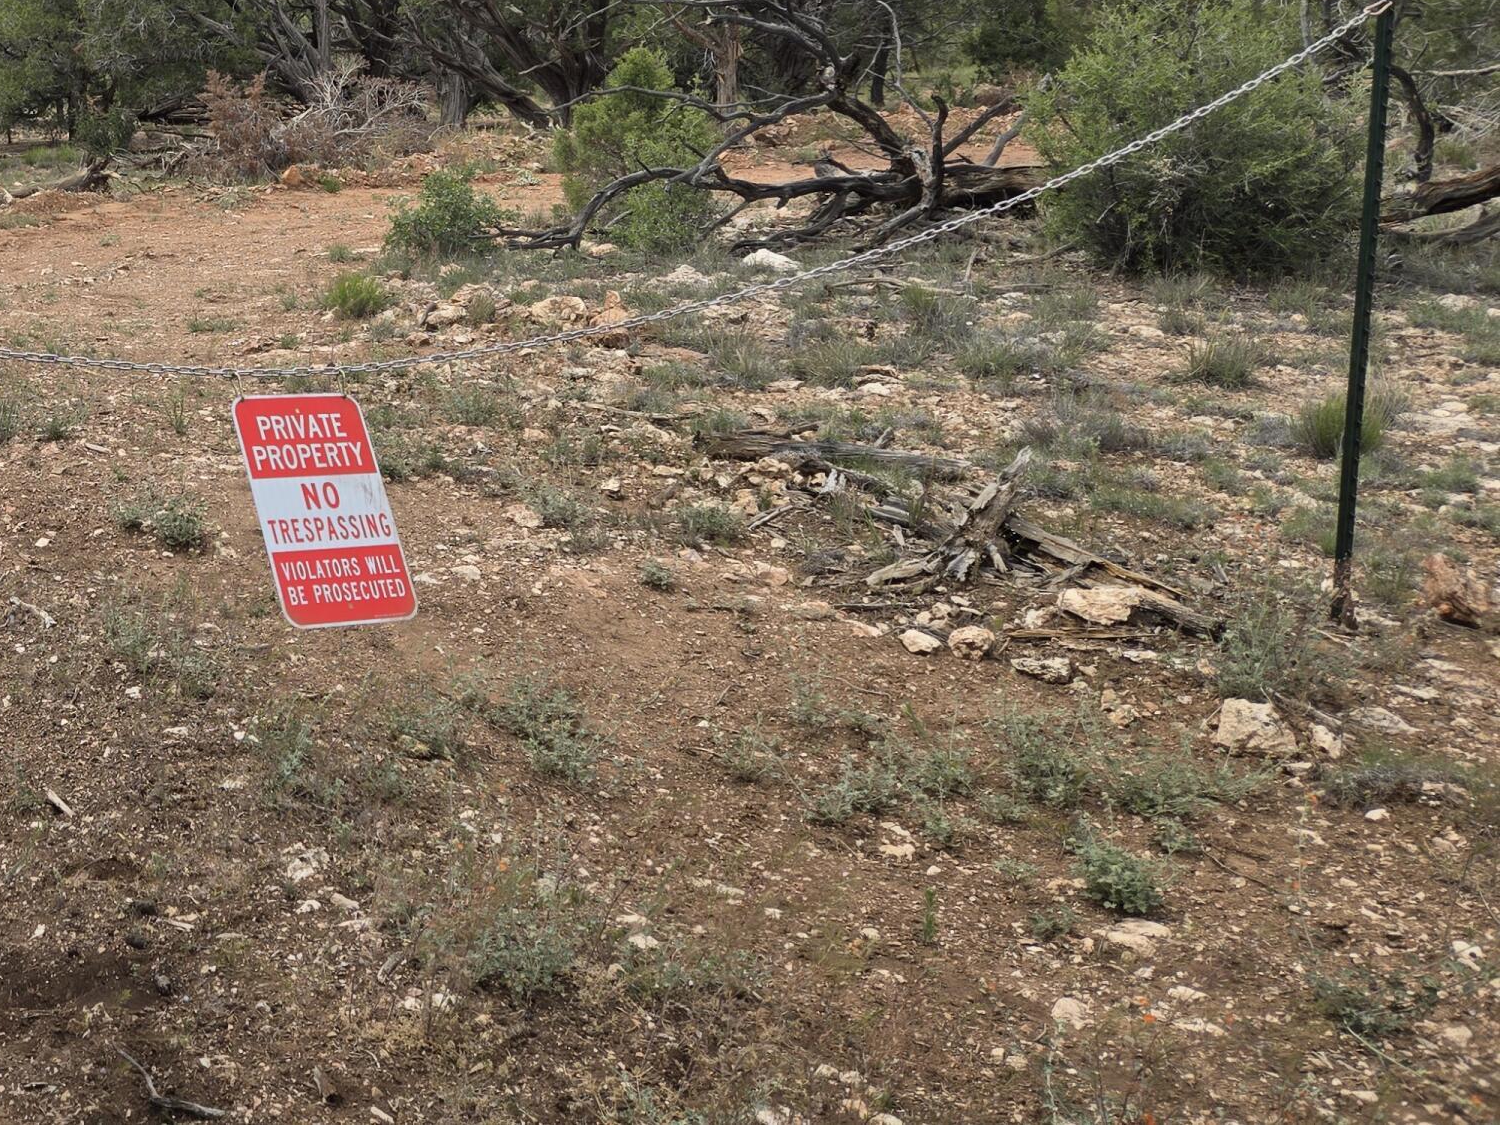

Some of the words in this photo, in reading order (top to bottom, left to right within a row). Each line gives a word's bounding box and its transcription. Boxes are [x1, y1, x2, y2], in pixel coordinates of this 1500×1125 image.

[256, 413, 347, 441] PRIVATE
[252, 442, 363, 471] PROPERTY
[301, 481, 340, 510] NO
[267, 513, 392, 544] TRESPASSING
[281, 557, 361, 581] VIOLATORS
[365, 555, 400, 574] WILL
[287, 586, 308, 606] BE
[313, 578, 406, 604] PROSECUTED
